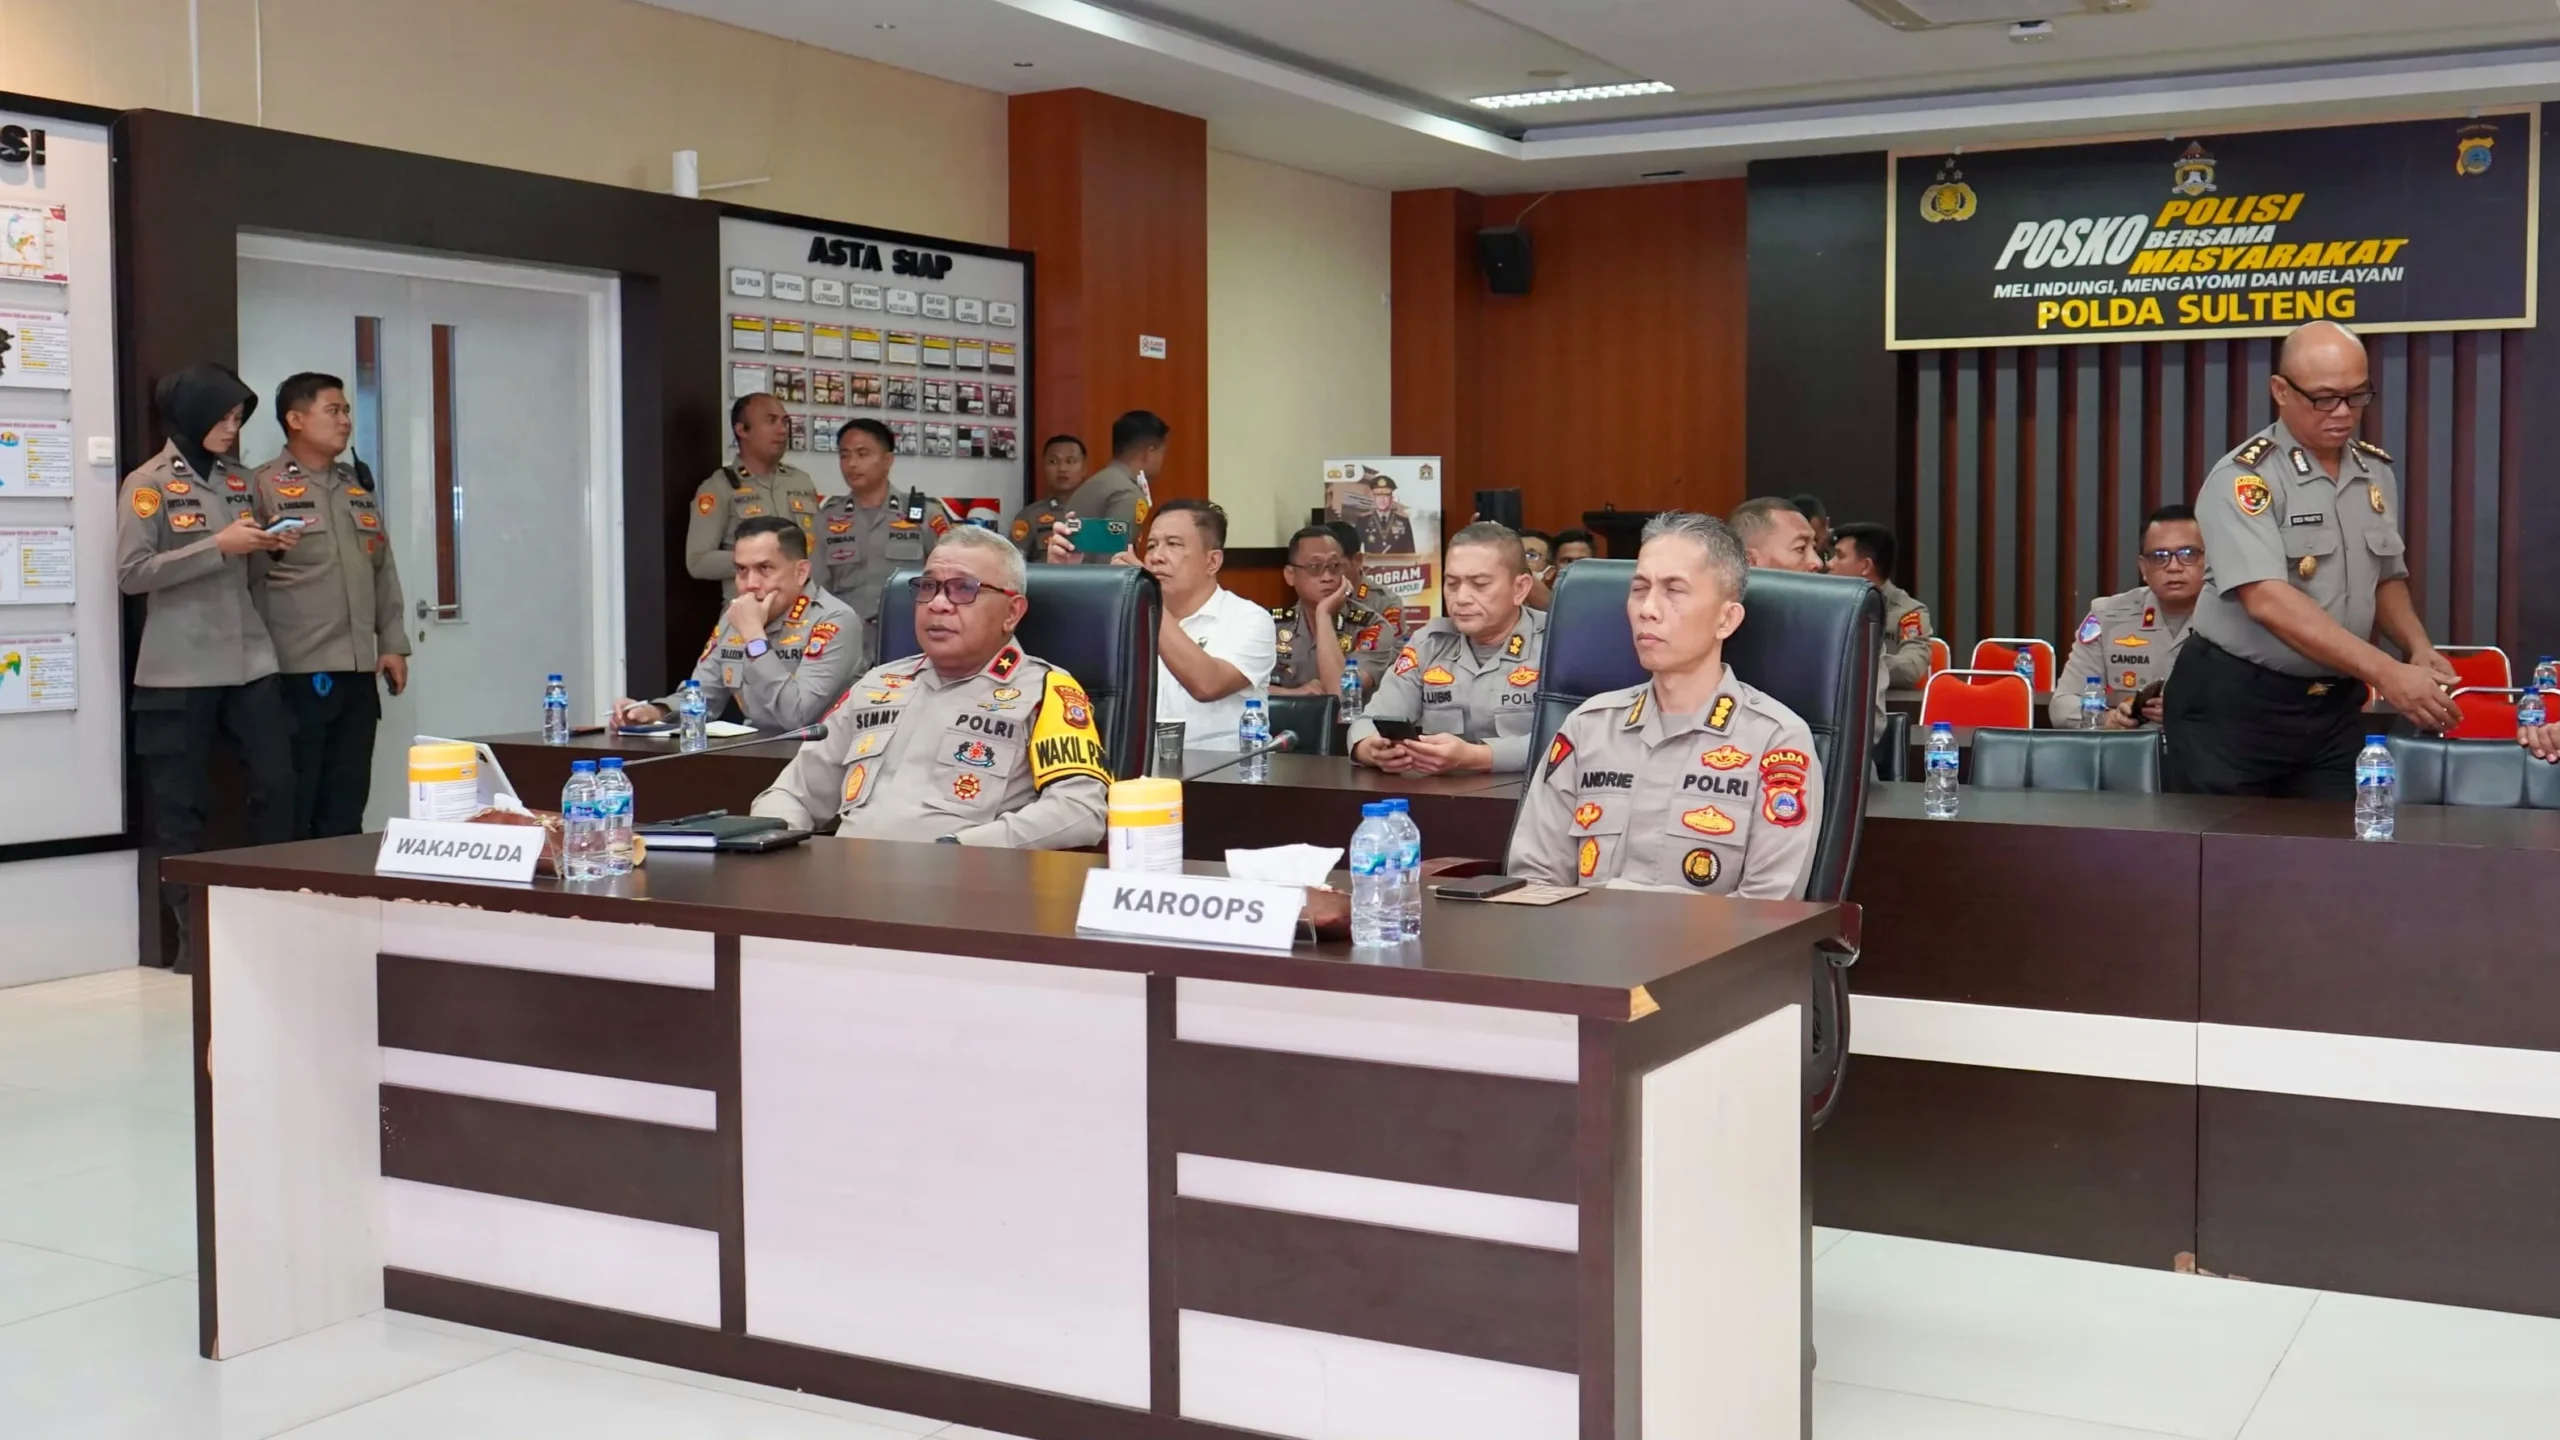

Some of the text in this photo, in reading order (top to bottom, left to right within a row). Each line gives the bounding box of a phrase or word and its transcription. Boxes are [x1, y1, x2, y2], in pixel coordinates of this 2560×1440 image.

[2155, 193, 2305, 228] POLISI
[1994, 214, 2149, 271] POSKO
[2144, 224, 2276, 249] BERSAMA
[807, 236, 953, 280] ASTA SIAP
[2128, 238, 2409, 275] MASYARAKAT
[1993, 266, 2405, 298] MELINDUNGI, MENGAYOMI DAN MELAYANI
[2038, 288, 2355, 330] POLDA SULTENG
[1367, 567, 1420, 585] OGRAM
[2110, 654, 2150, 665] CANDRA
[856, 710, 900, 729] SEMMY
[955, 714, 1015, 739] POLRI
[1035, 736, 1087, 769] WAKIL
[1762, 752, 1804, 768] POLDA
[1580, 771, 1634, 789] ANDRIE
[1683, 774, 1749, 797] POLRI
[396, 837, 522, 863] WAKAPOLDA
[1113, 887, 1265, 923] KAROOPS
